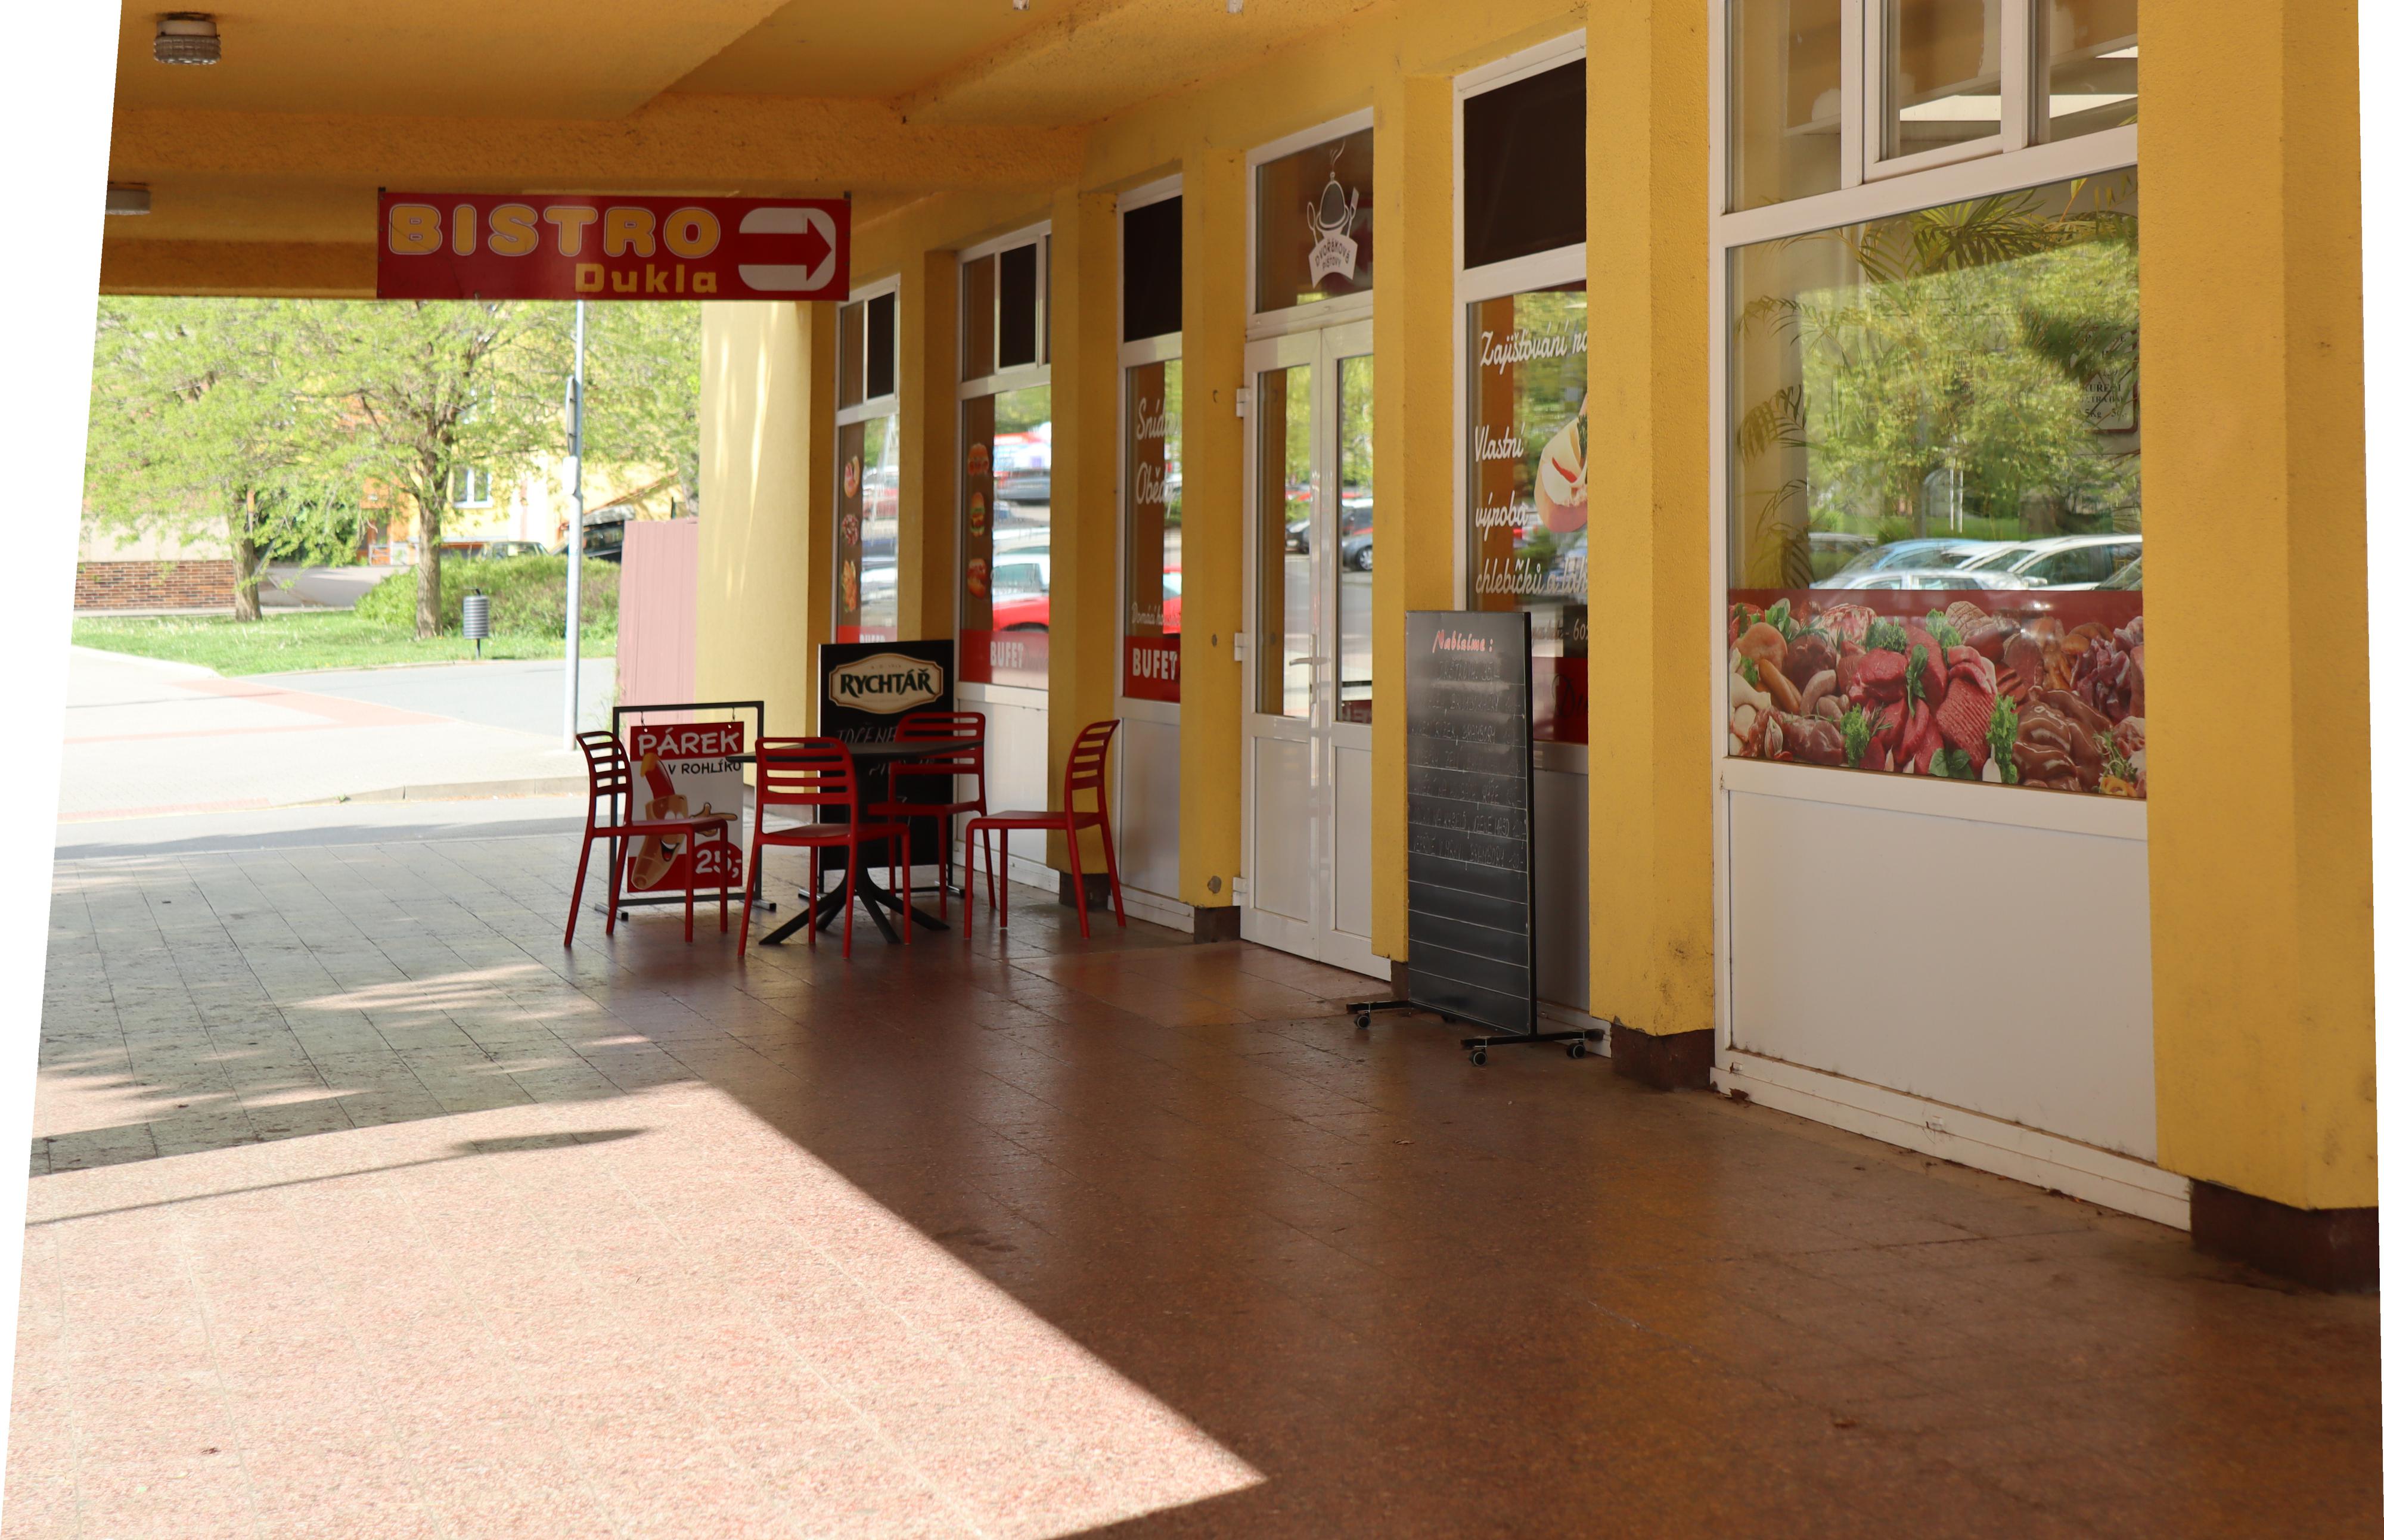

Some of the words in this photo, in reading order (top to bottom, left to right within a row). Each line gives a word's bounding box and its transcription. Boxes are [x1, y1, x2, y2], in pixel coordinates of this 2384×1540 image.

[389, 204, 721, 259] BISTRO
[575, 263, 718, 293] Dukla
[1475, 421, 1525, 462] Vlastní
[1475, 490, 1529, 542] výroba
[1476, 557, 1544, 594] chlebíčků
[991, 641, 1024, 668] BUFET
[1132, 648, 1178, 681] BUFET
[840, 668, 935, 698] RYCHTÁŘ
[638, 727, 740, 757] PÁREK
[669, 763, 676, 775] V
